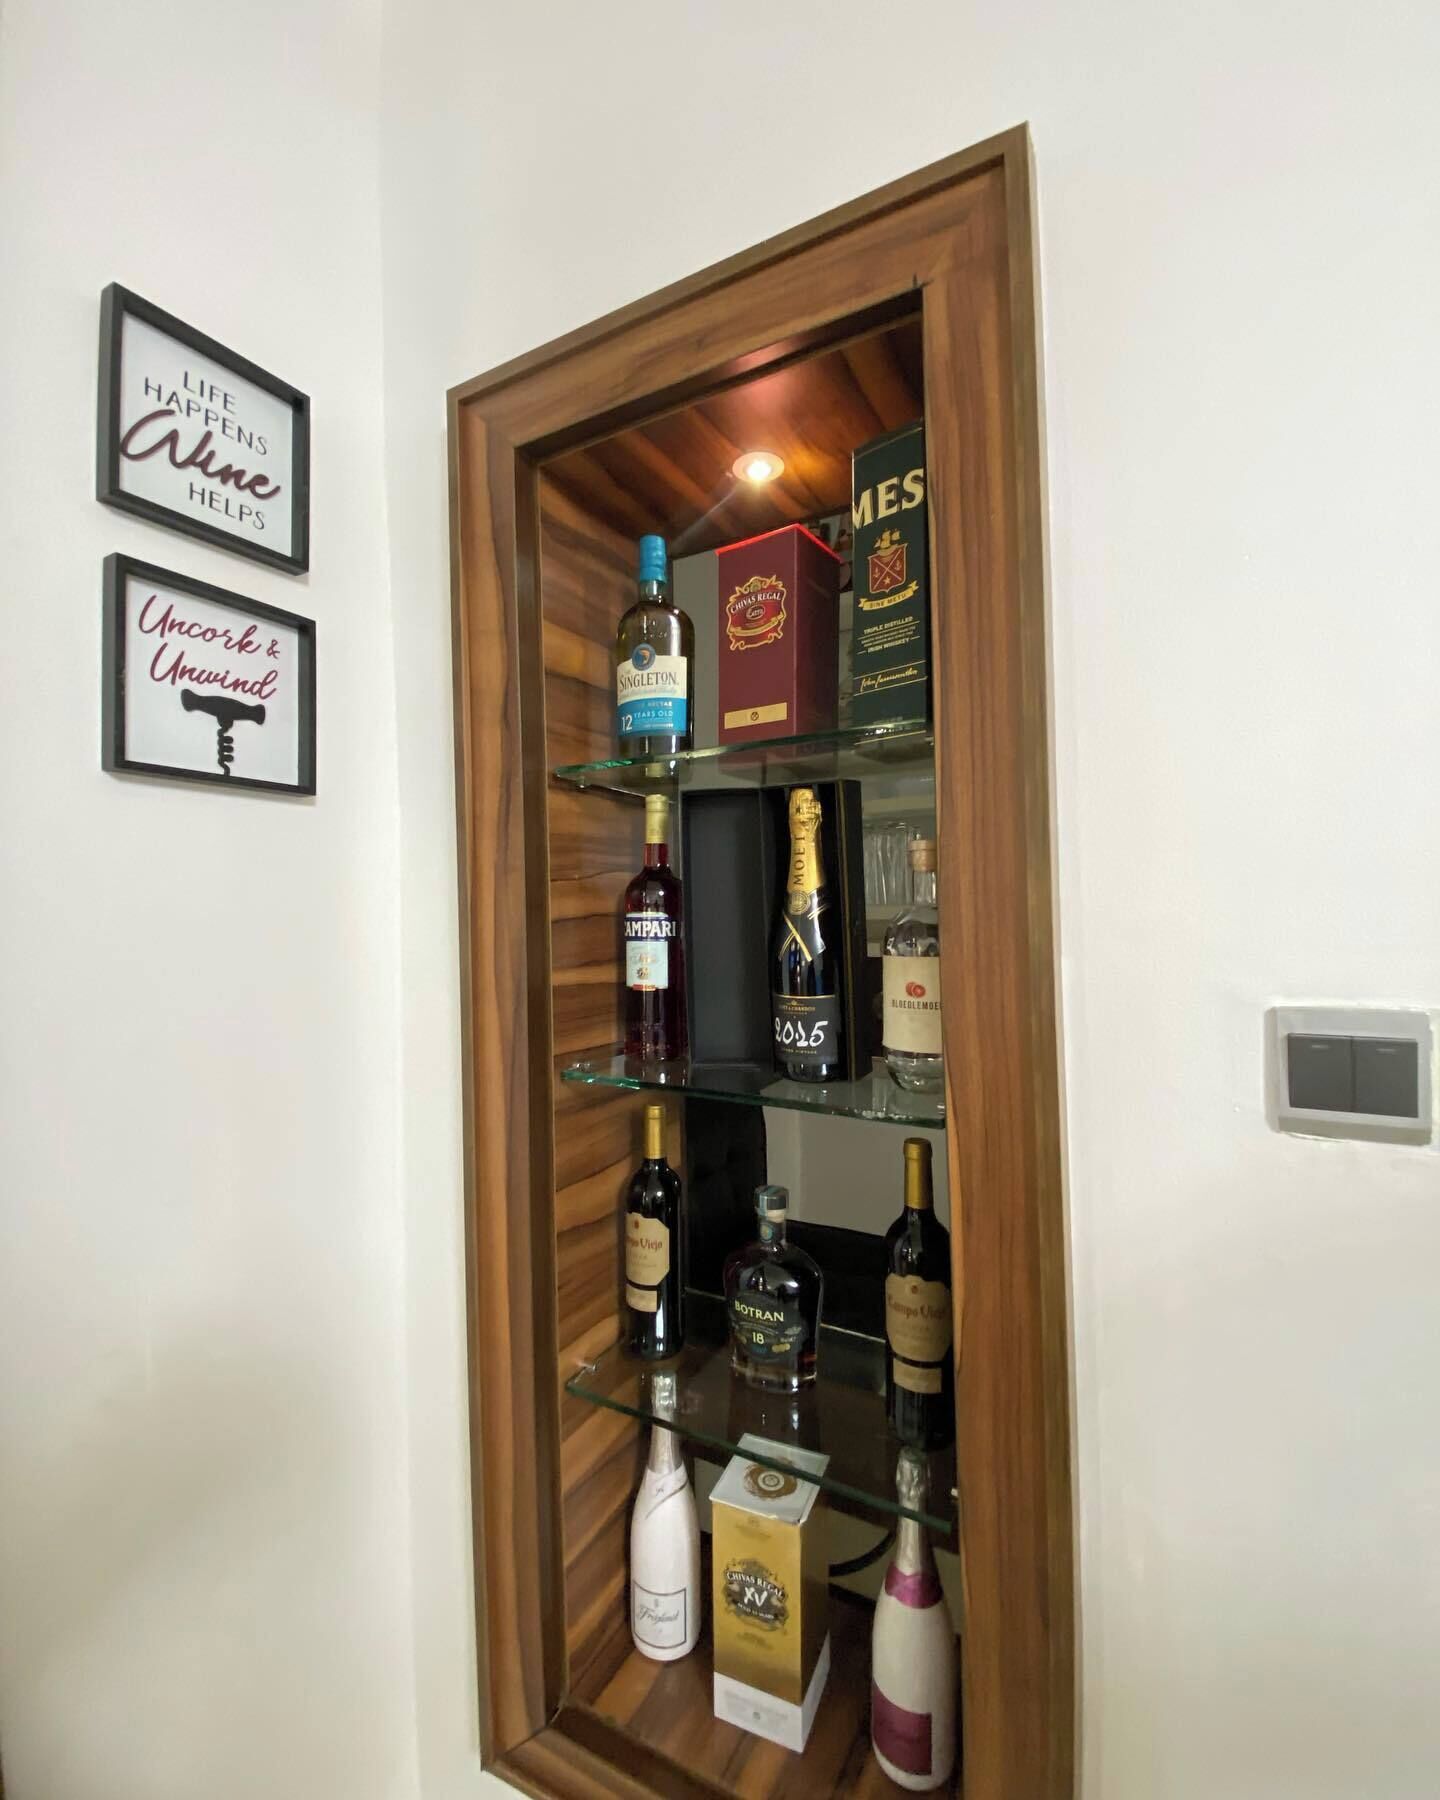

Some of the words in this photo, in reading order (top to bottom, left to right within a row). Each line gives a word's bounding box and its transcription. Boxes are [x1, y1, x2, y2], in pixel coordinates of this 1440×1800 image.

[183, 371, 236, 414] LIFE
[144, 376, 268, 456] HAPPENS
[119, 408, 281, 500] Wine
[189, 481, 265, 530] HELPS
[730, 595, 756, 614] CHIVAS
[757, 592, 781, 601] REGAL
[138, 594, 262, 655] Uncork
[266, 639, 281, 659] &
[150, 642, 279, 700] Unwind
[619, 671, 676, 692] SINGLETON
[621, 714, 632, 731] 12
[624, 920, 677, 937] AMPARI
[775, 1016, 829, 1047] 2015
[735, 1300, 785, 1322] BOTRAN
[752, 1332, 765, 1345] 18
[726, 1571, 755, 1584] CHIVAS
[757, 1577, 784, 1598] REGAL
[743, 1586, 768, 1607] XV
